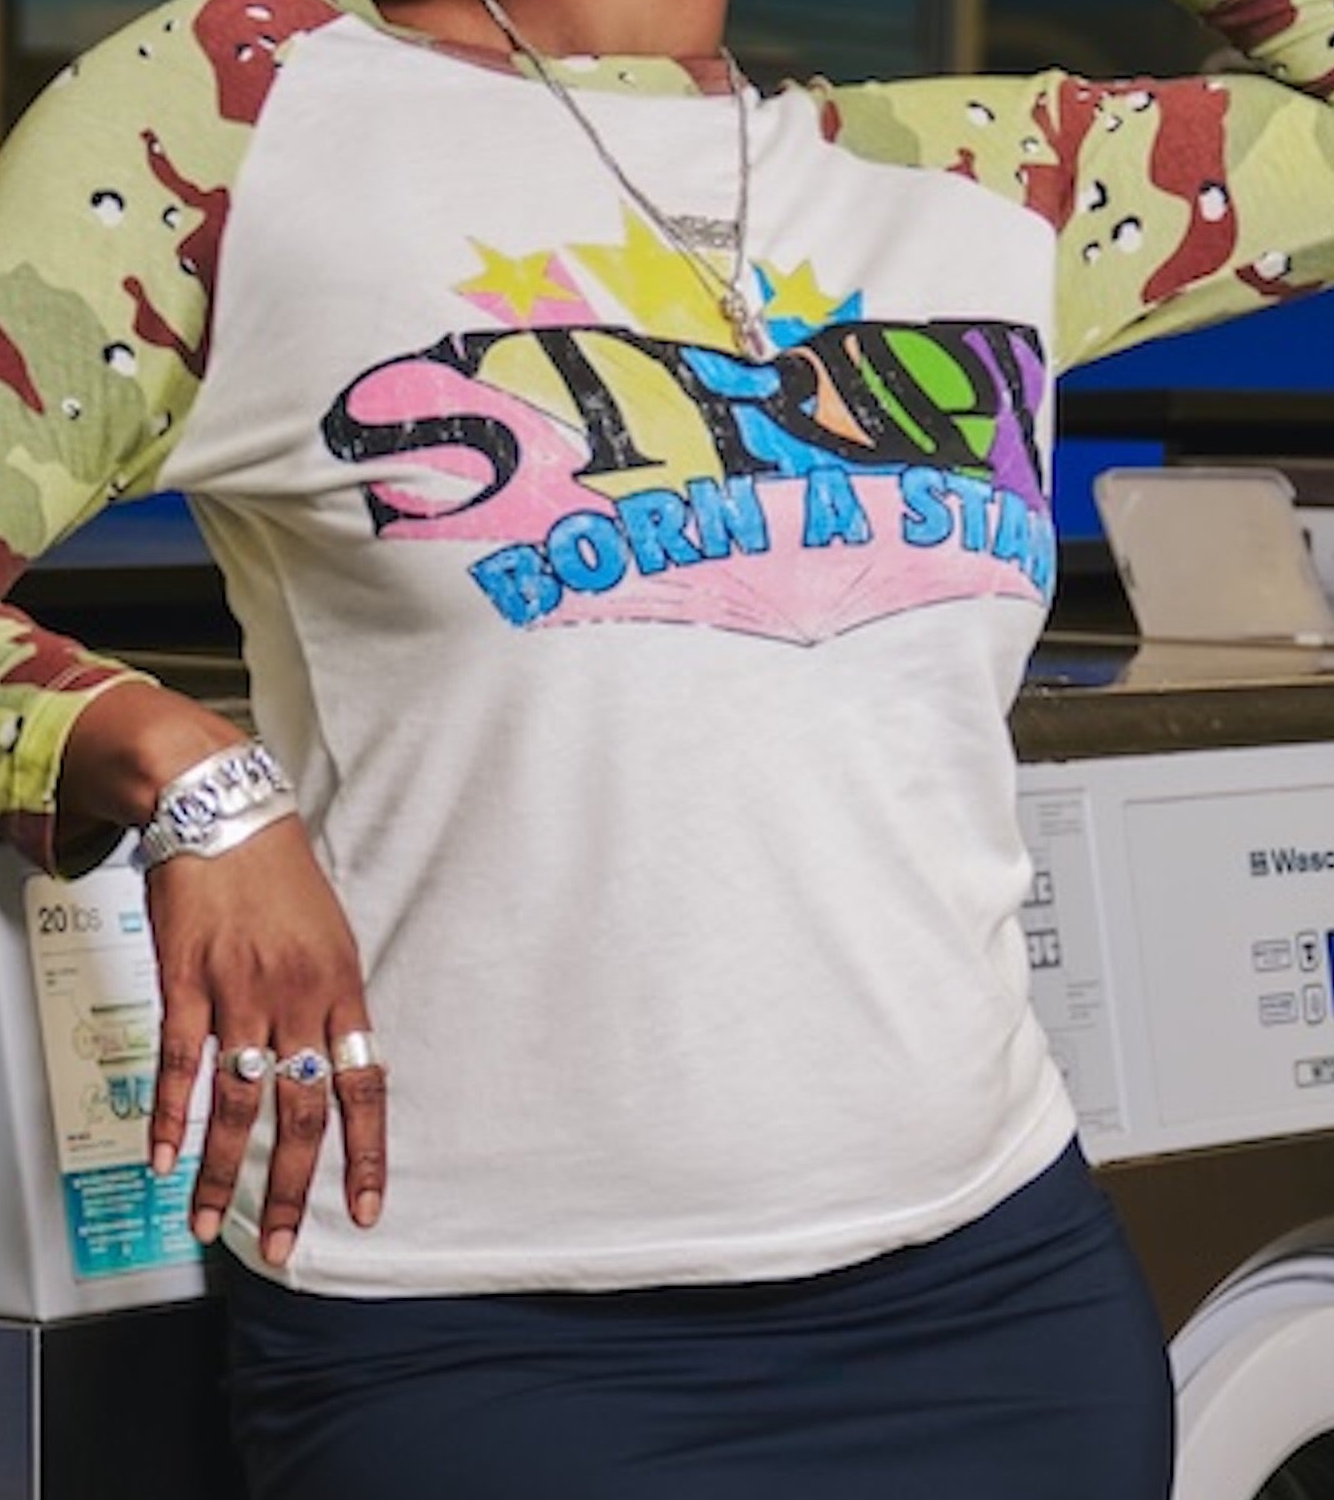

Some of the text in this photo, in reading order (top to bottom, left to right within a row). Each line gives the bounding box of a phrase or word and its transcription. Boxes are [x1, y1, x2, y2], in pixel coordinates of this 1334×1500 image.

[467, 475, 769, 632] BORN
[803, 465, 873, 548] A
[38, 904, 68, 934] 20
